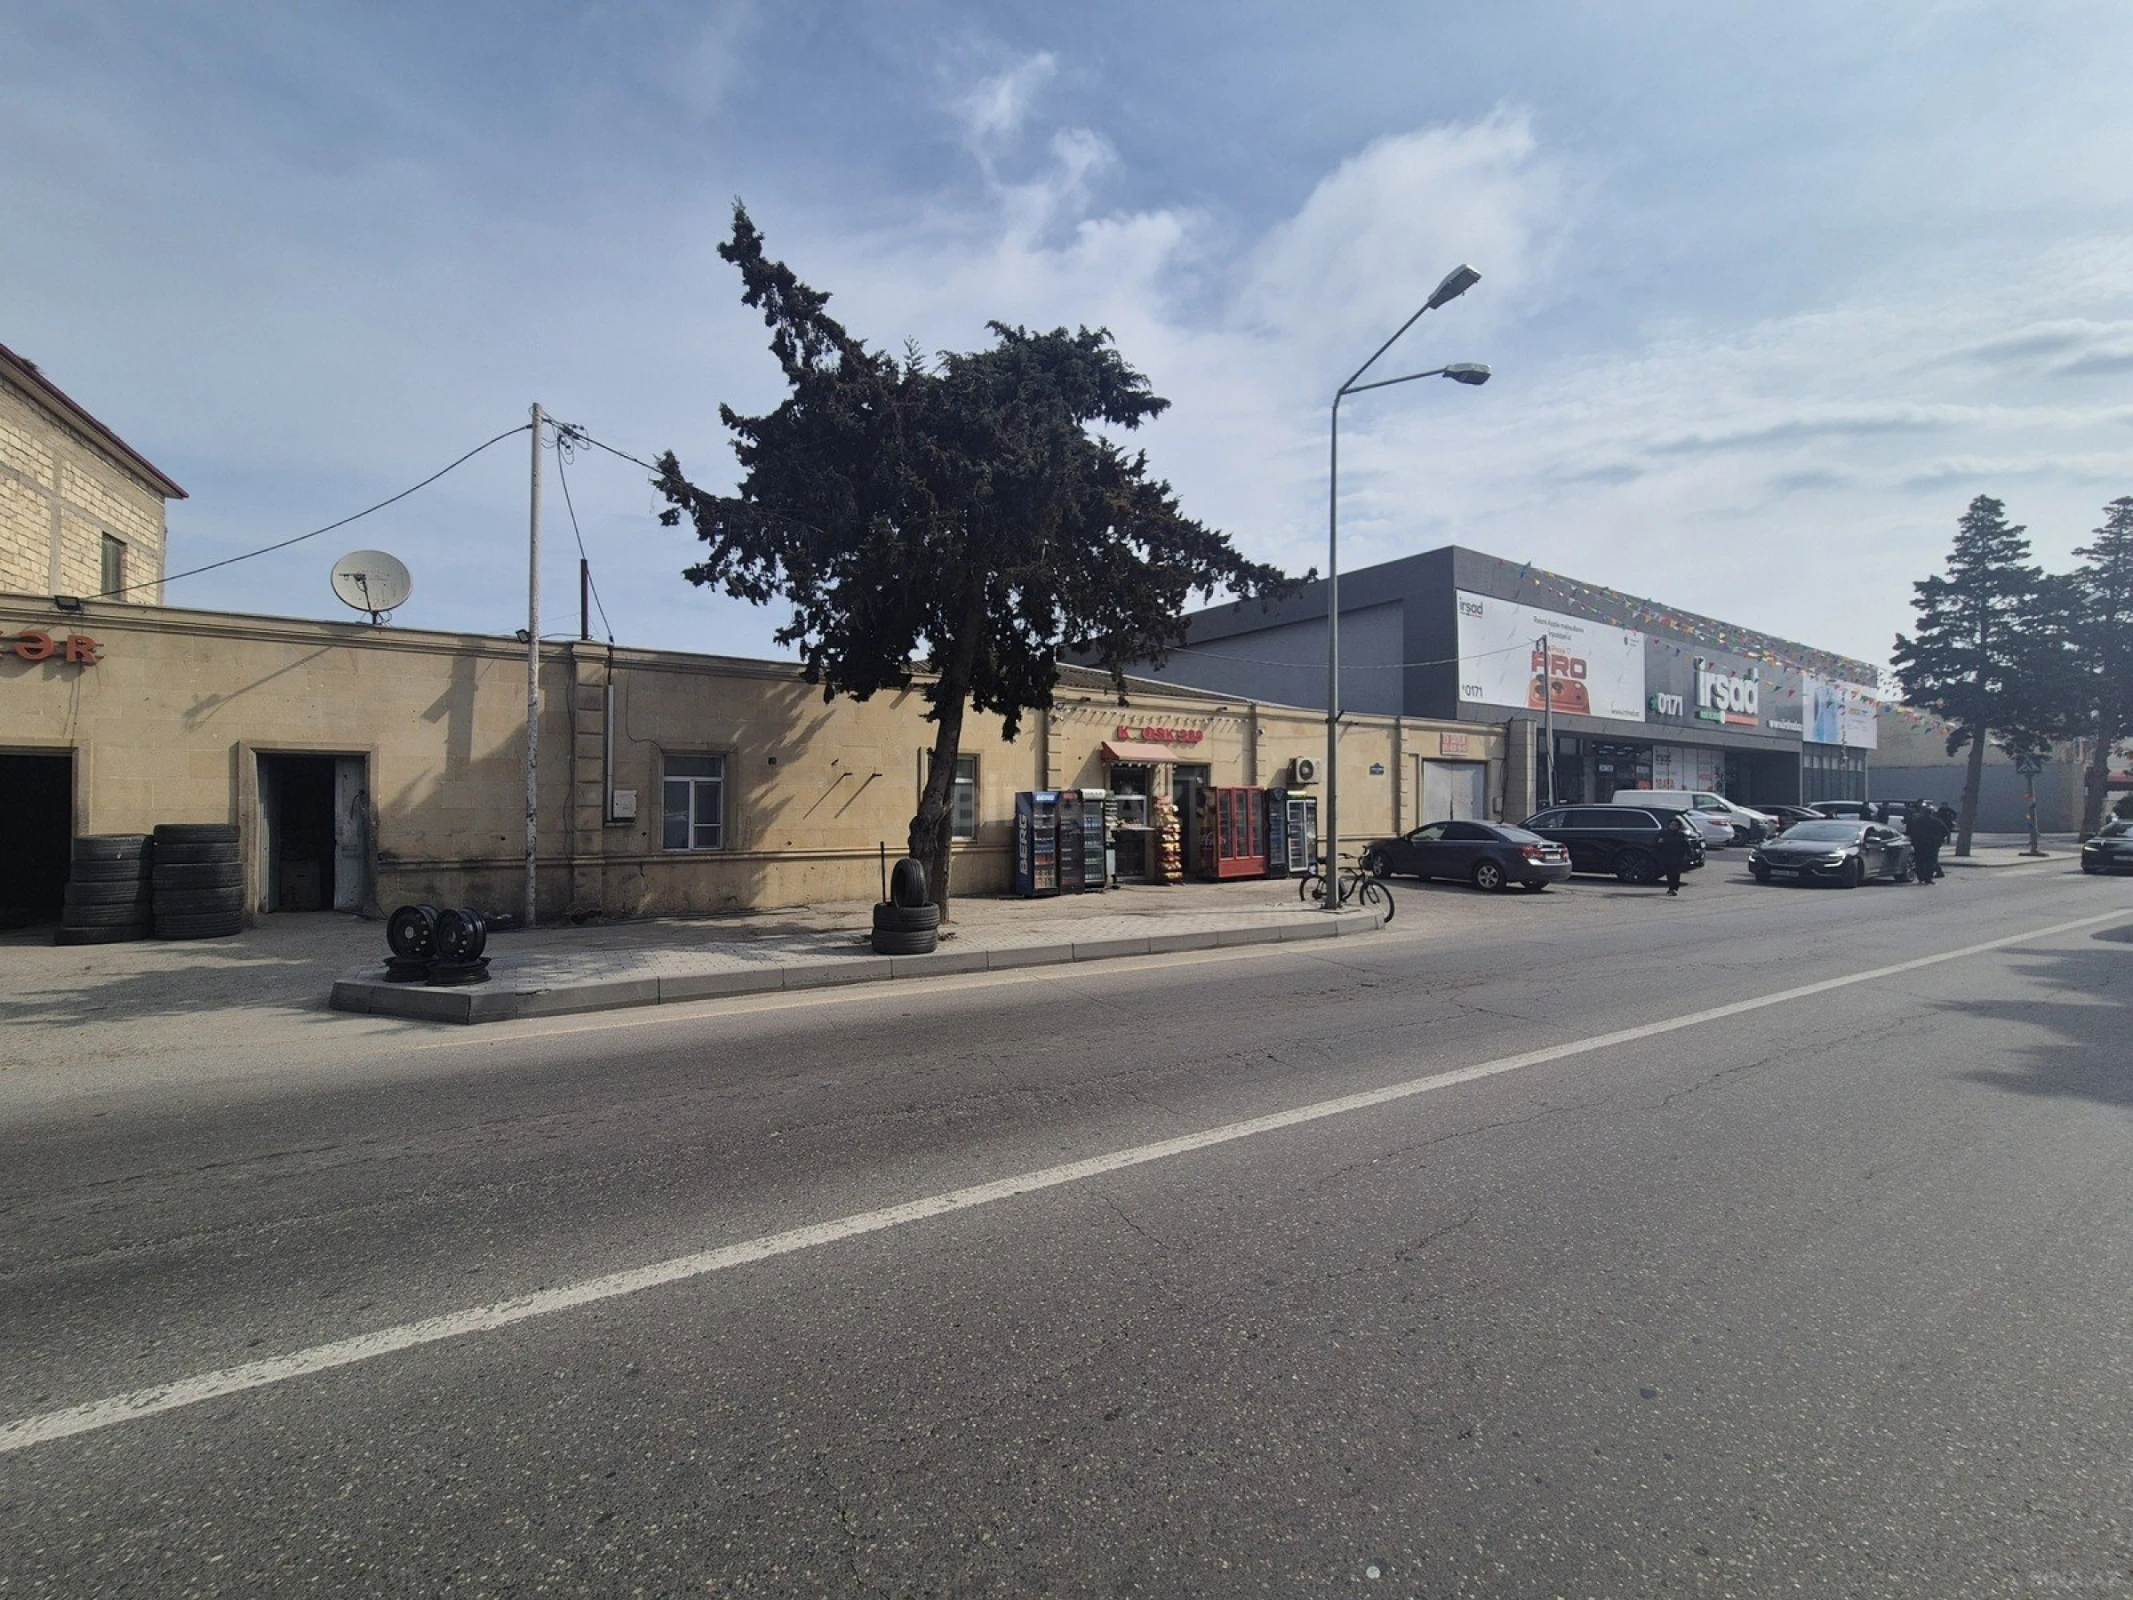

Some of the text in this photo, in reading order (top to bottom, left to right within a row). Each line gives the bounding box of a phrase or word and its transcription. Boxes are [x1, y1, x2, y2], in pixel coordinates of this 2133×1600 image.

[0, 630, 98, 666] ƏR
[1532, 650, 1587, 680] PRO
[1019, 814, 1028, 875] BERG
